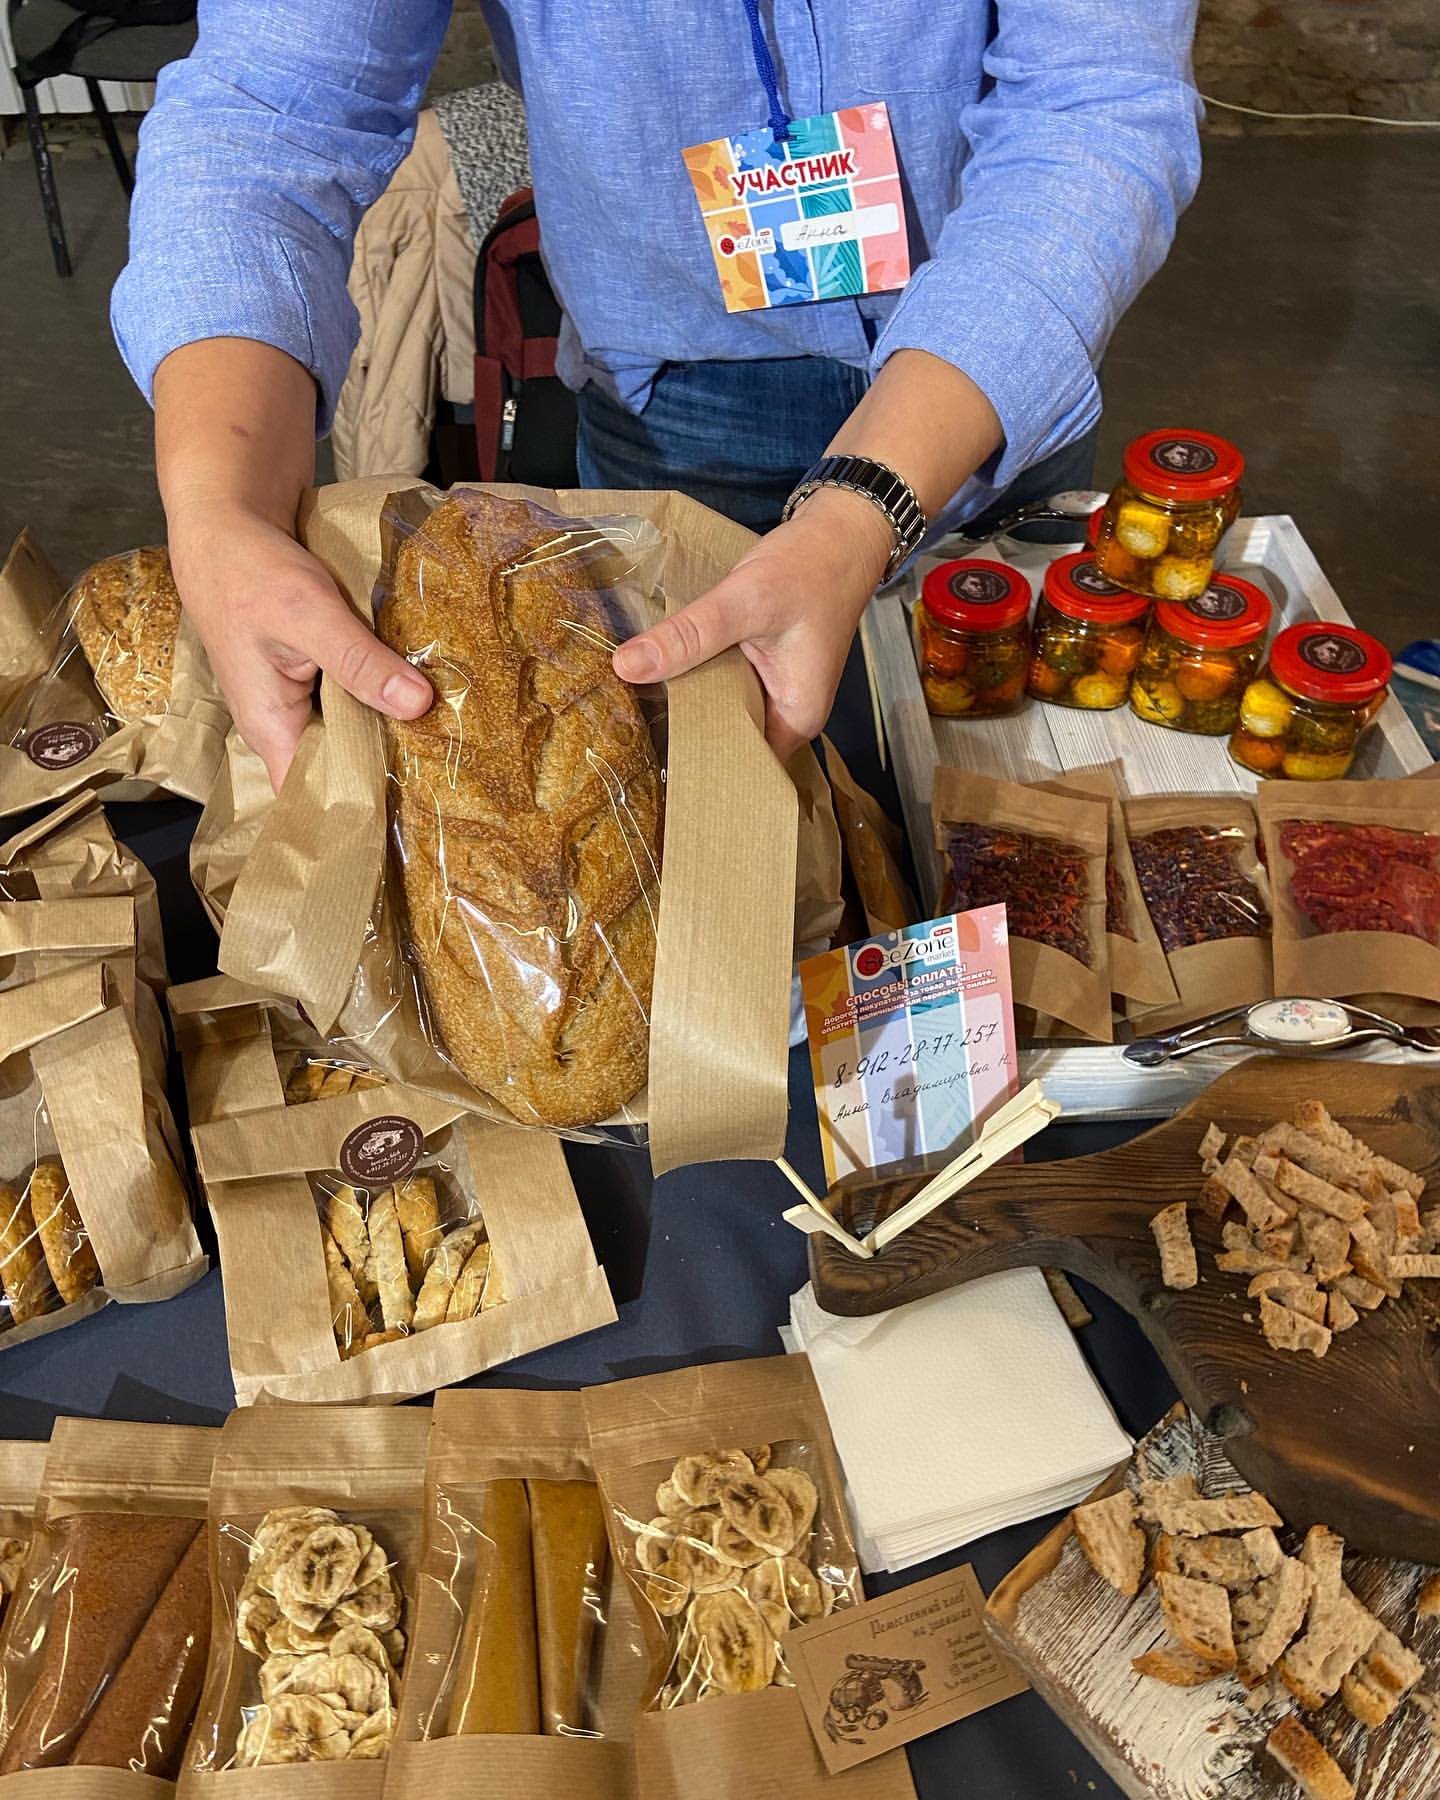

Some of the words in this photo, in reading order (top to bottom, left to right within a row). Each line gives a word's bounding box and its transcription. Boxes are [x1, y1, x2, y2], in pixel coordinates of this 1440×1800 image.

[732, 152, 855, 196] УЧАСТНИК
[796, 224, 847, 241] Анна
[926, 949, 955, 962] market
[821, 1017, 858, 1035] оплатить
[858, 1003, 905, 1021] наличными
[922, 986, 965, 1002] перевести
[966, 977, 997, 990] онлайн
[824, 1005, 859, 1026] Дорогой
[920, 982, 945, 995] товар
[959, 970, 992, 983] можете
[845, 979, 909, 1007] СПОСОБЫ
[911, 963, 967, 986] ОПЛАТЫ
[833, 1100, 872, 1122] Анна
